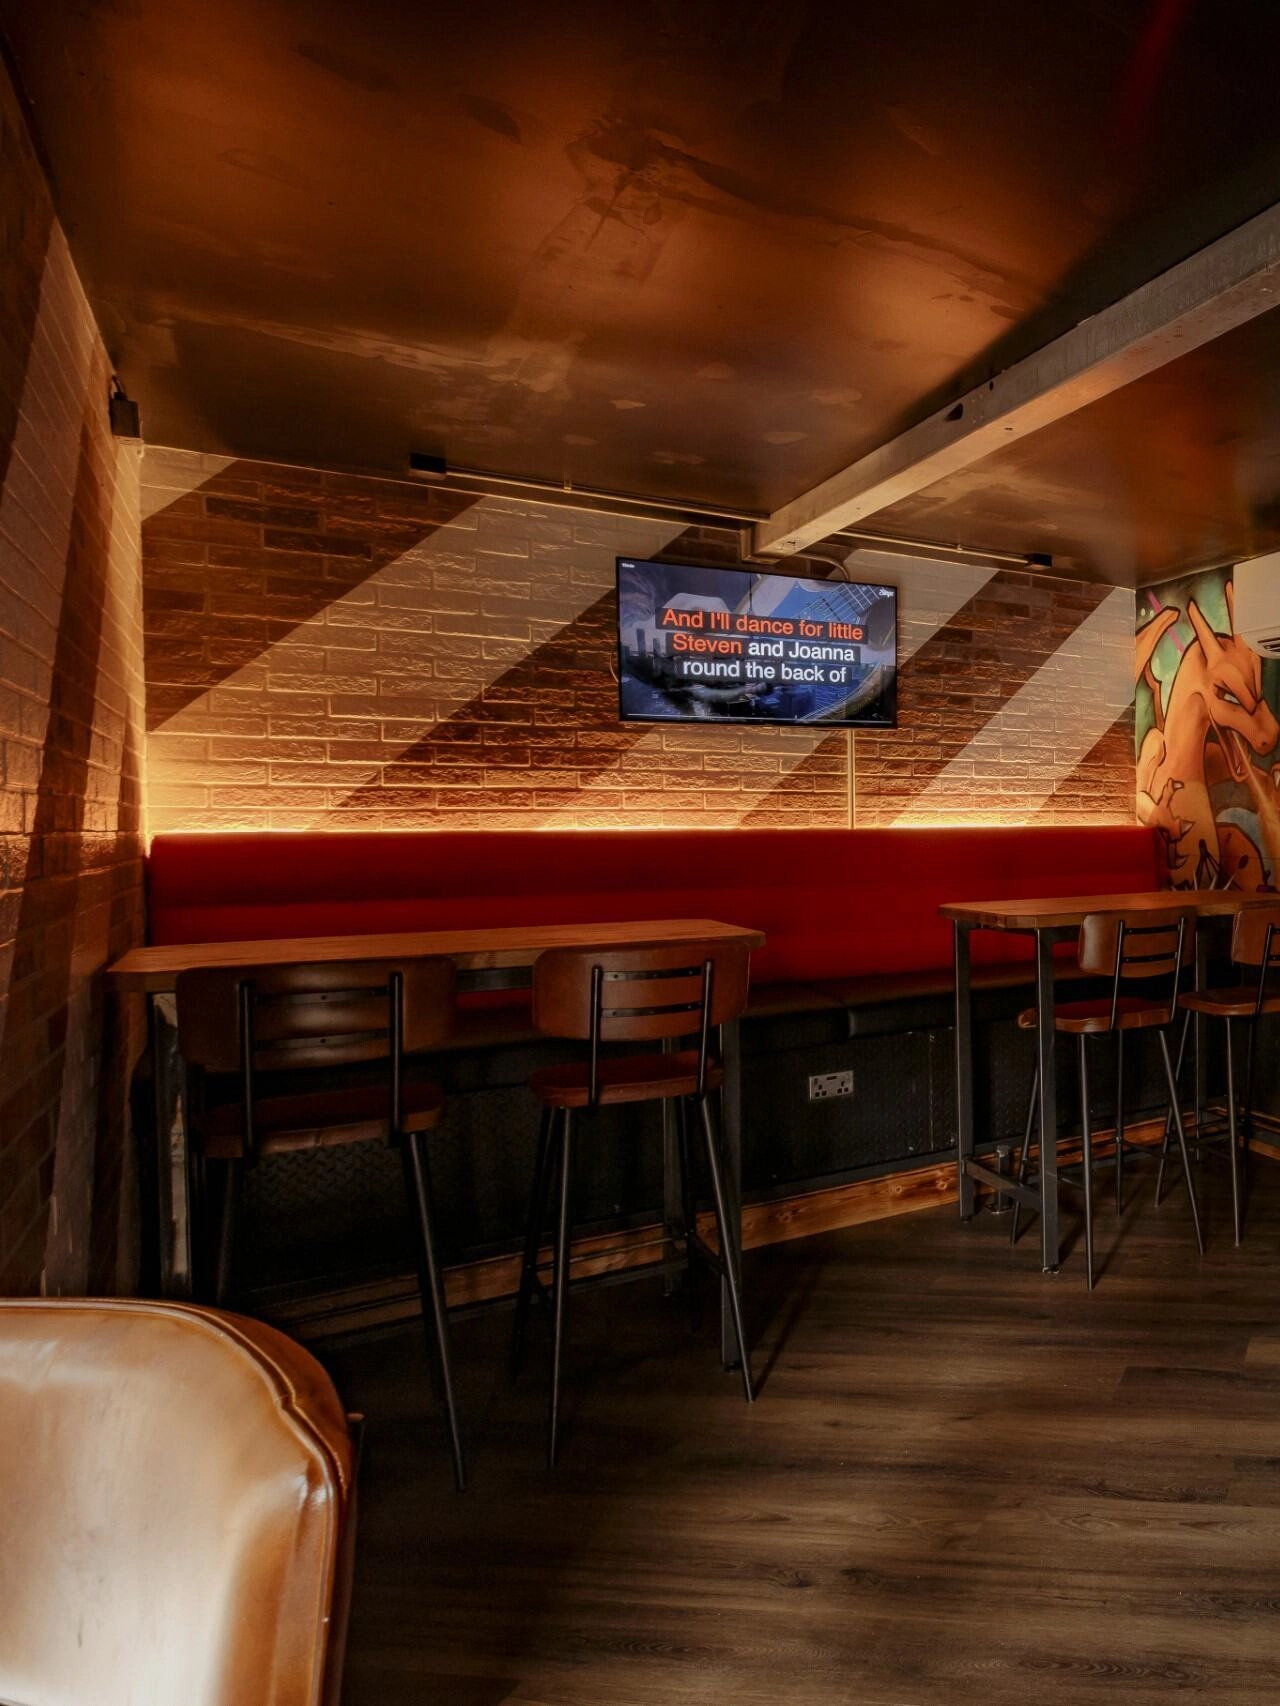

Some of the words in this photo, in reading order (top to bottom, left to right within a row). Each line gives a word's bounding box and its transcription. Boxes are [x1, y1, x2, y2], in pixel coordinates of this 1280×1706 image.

[662, 608, 704, 628] And
[711, 612, 729, 630] I'll
[736, 615, 794, 635] dance
[799, 619, 824, 637] for
[828, 621, 864, 640] little
[672, 633, 742, 654] Steven
[748, 640, 784, 657] and
[788, 642, 855, 661] Joanna
[683, 660, 740, 677] round
[745, 661, 776, 679] the
[781, 663, 825, 681] back
[829, 667, 847, 683] of
